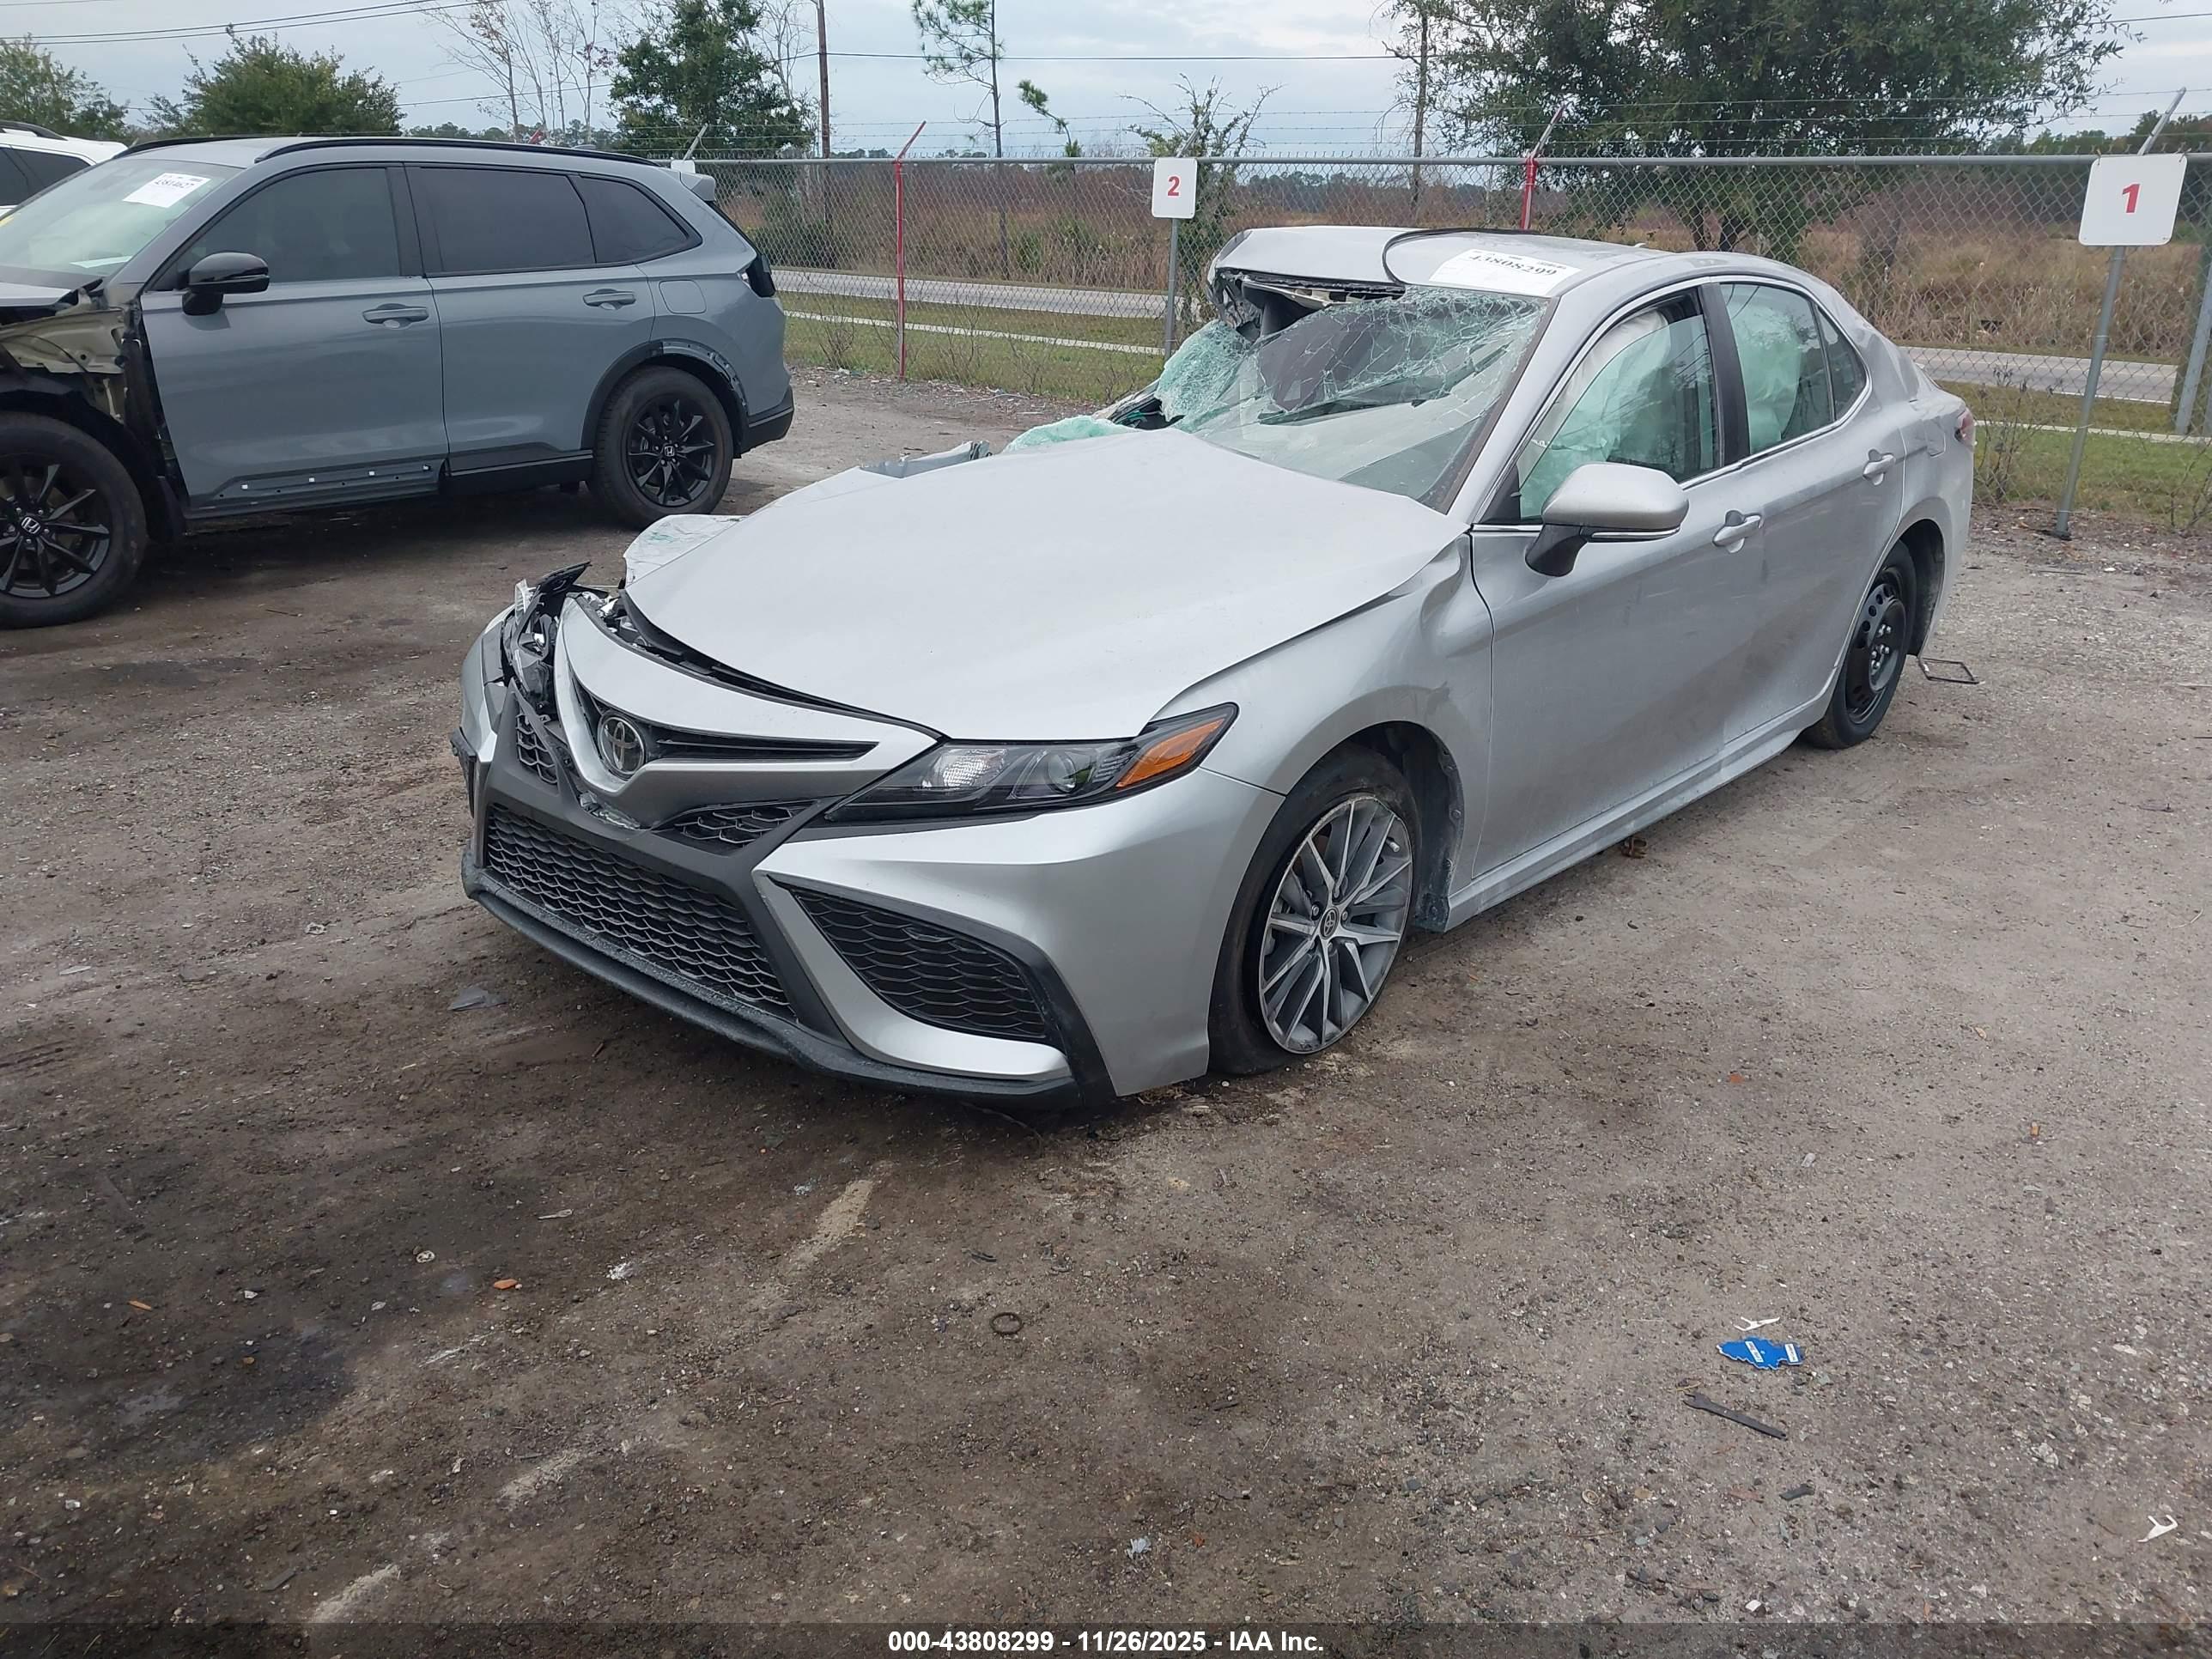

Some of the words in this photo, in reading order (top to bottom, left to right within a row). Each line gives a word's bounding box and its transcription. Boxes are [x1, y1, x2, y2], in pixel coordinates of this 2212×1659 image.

[1168, 175, 1180, 197] 2
[2122, 183, 2141, 214] 1
[1469, 254, 1558, 276] 43808299
